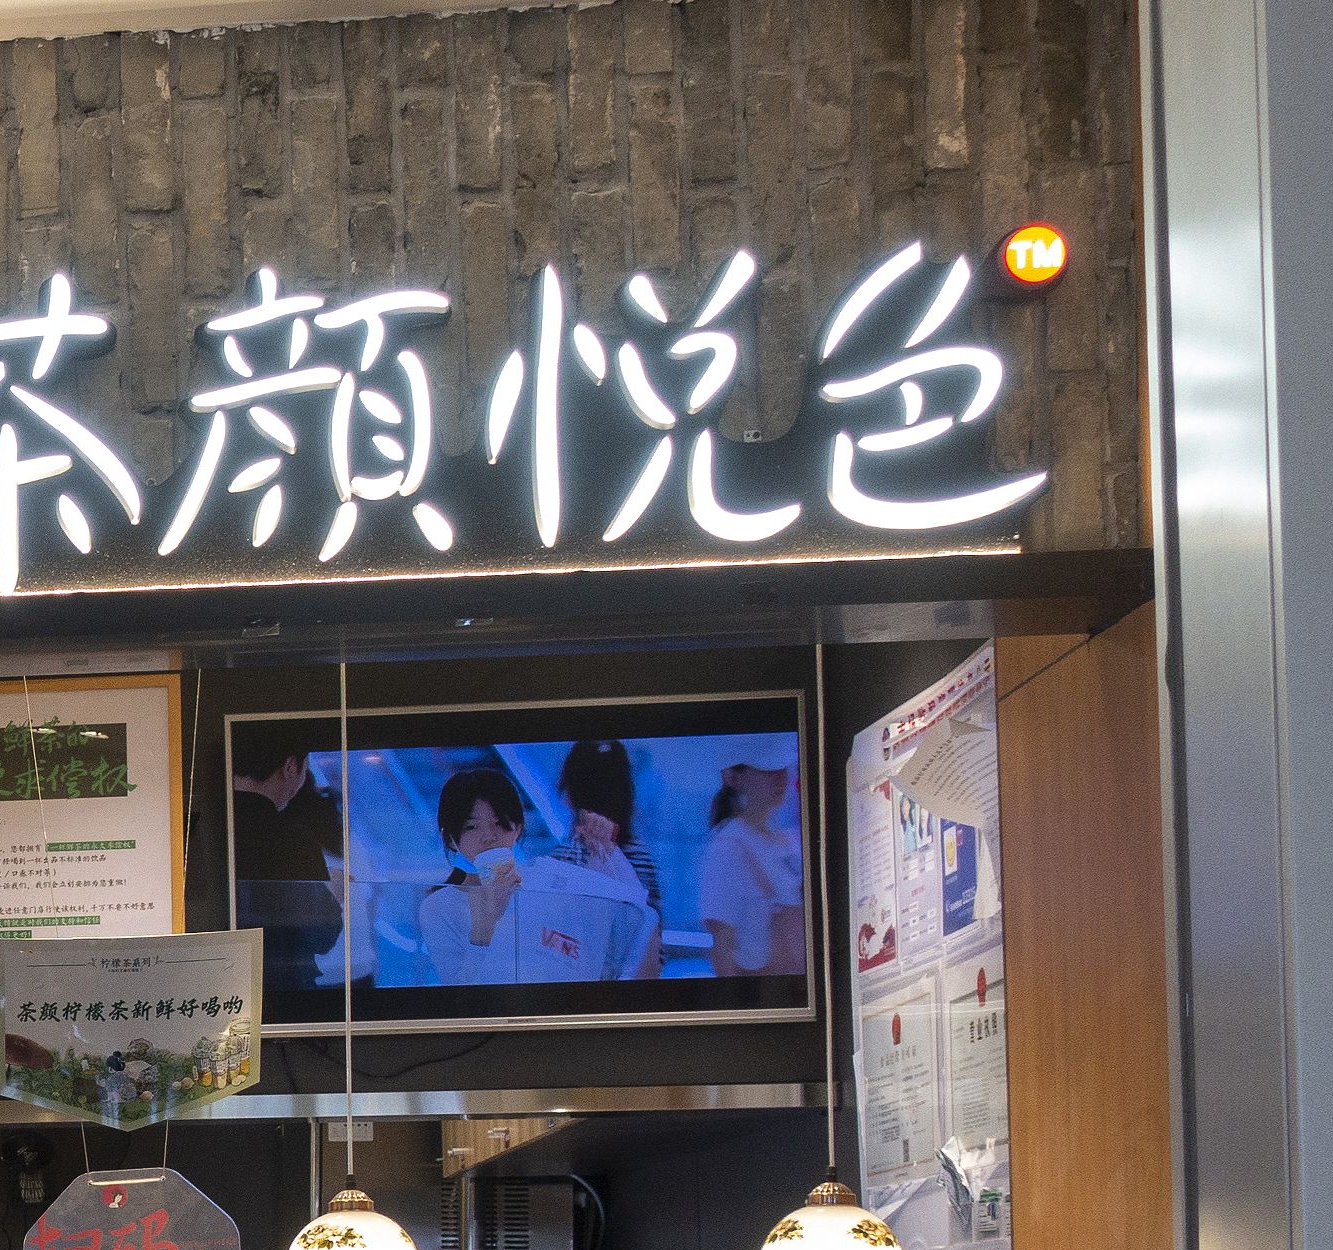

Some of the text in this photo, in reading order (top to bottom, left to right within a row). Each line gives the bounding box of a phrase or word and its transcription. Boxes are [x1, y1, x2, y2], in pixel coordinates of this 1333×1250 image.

[1009, 236, 1062, 269] TM
[17, 995, 243, 1022] 茶颜柠檬茶新鲜好喝哟
